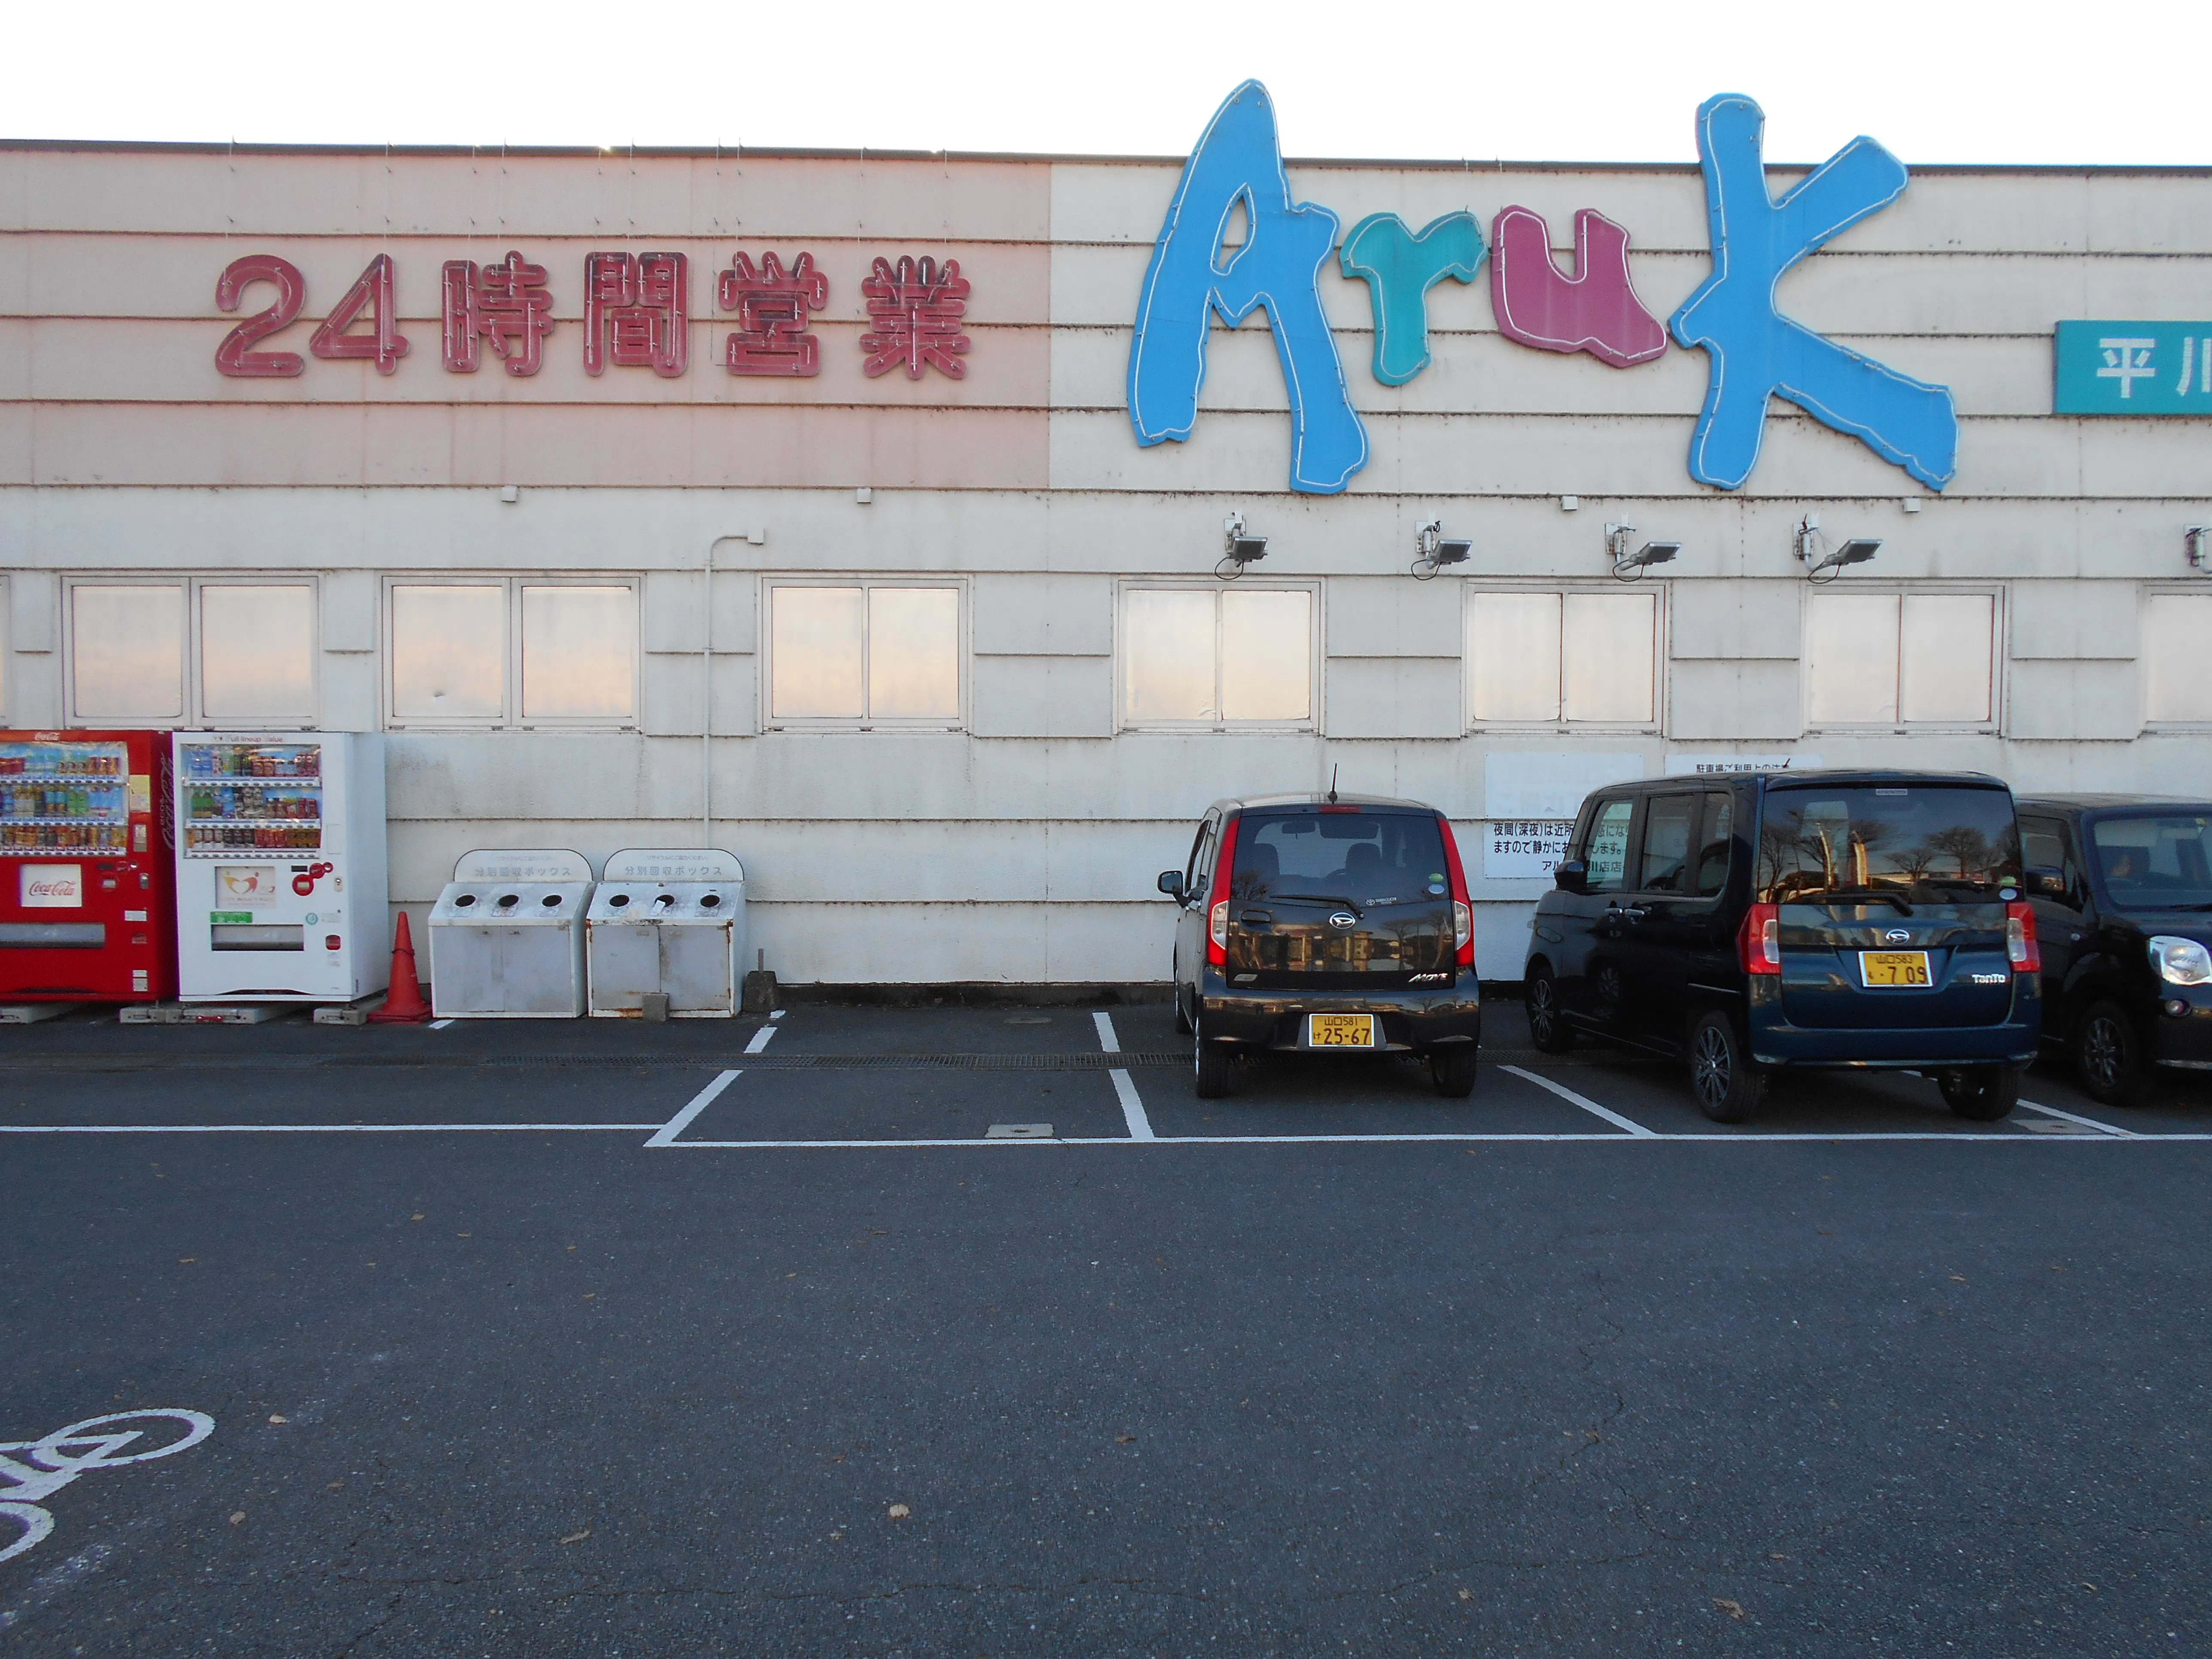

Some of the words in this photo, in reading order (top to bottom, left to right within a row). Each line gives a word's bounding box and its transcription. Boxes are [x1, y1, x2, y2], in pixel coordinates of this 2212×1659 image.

[215, 250, 971, 380] 24時間営業
[625, 866, 722, 875] 分別回収ボックス
[1409, 973, 1448, 982] MOVE
[1324, 1027, 1370, 1045] 25-67
